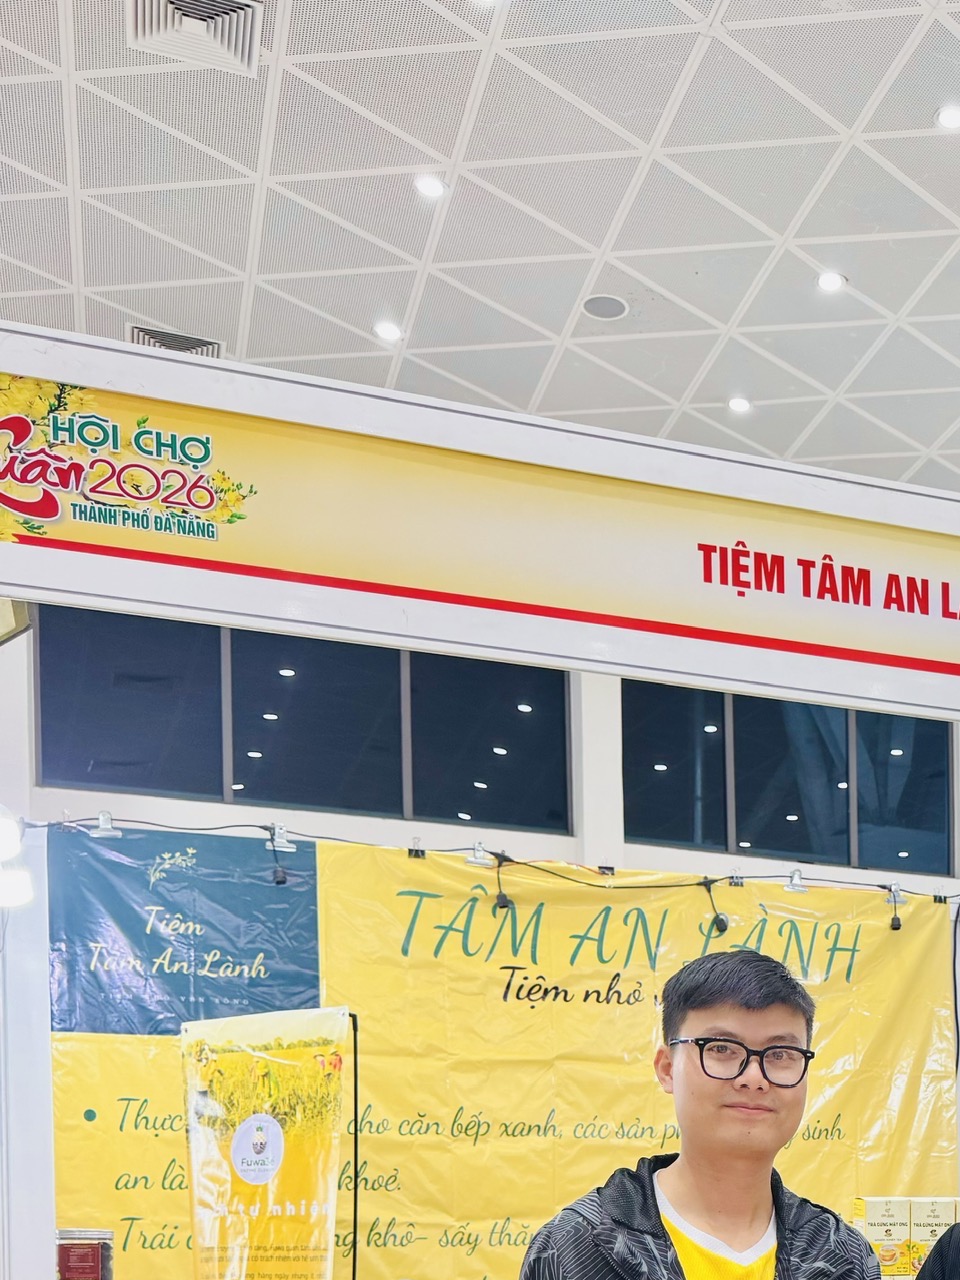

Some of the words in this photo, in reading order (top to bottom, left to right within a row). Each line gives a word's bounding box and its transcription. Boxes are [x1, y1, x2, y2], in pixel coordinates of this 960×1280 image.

[51, 413, 119, 456] HỘI
[134, 428, 212, 470] CHỢ
[89, 458, 216, 511] 2026
[70, 502, 117, 526] THÀNH
[122, 507, 150, 530] PHỐ
[154, 514, 172, 534] ĐÀ
[697, 540, 785, 597] TIỆM
[797, 554, 871, 607] TÂM
[883, 573, 929, 616] AN
[144, 906, 205, 940] Tiệm
[396, 883, 544, 966] TÂM
[569, 905, 669, 971] AN
[683, 903, 861, 984] LÀNH
[152, 947, 191, 975] An
[197, 950, 271, 979] Lành
[499, 965, 574, 1010] Tiệm
[583, 968, 644, 1006] nhỏ
[117, 1097, 184, 1137] Thực
[347, 1104, 392, 1137] cho
[399, 1109, 448, 1138] căn
[451, 1106, 492, 1146] bếp
[499, 1110, 563, 1140] xanh,
[573, 1114, 610, 1140] các
[614, 1115, 658, 1141] sản
[802, 1113, 846, 1142] sinh
[115, 1167, 154, 1191] an
[120, 1217, 180, 1252] Trái
[438, 1218, 481, 1256] sấy
